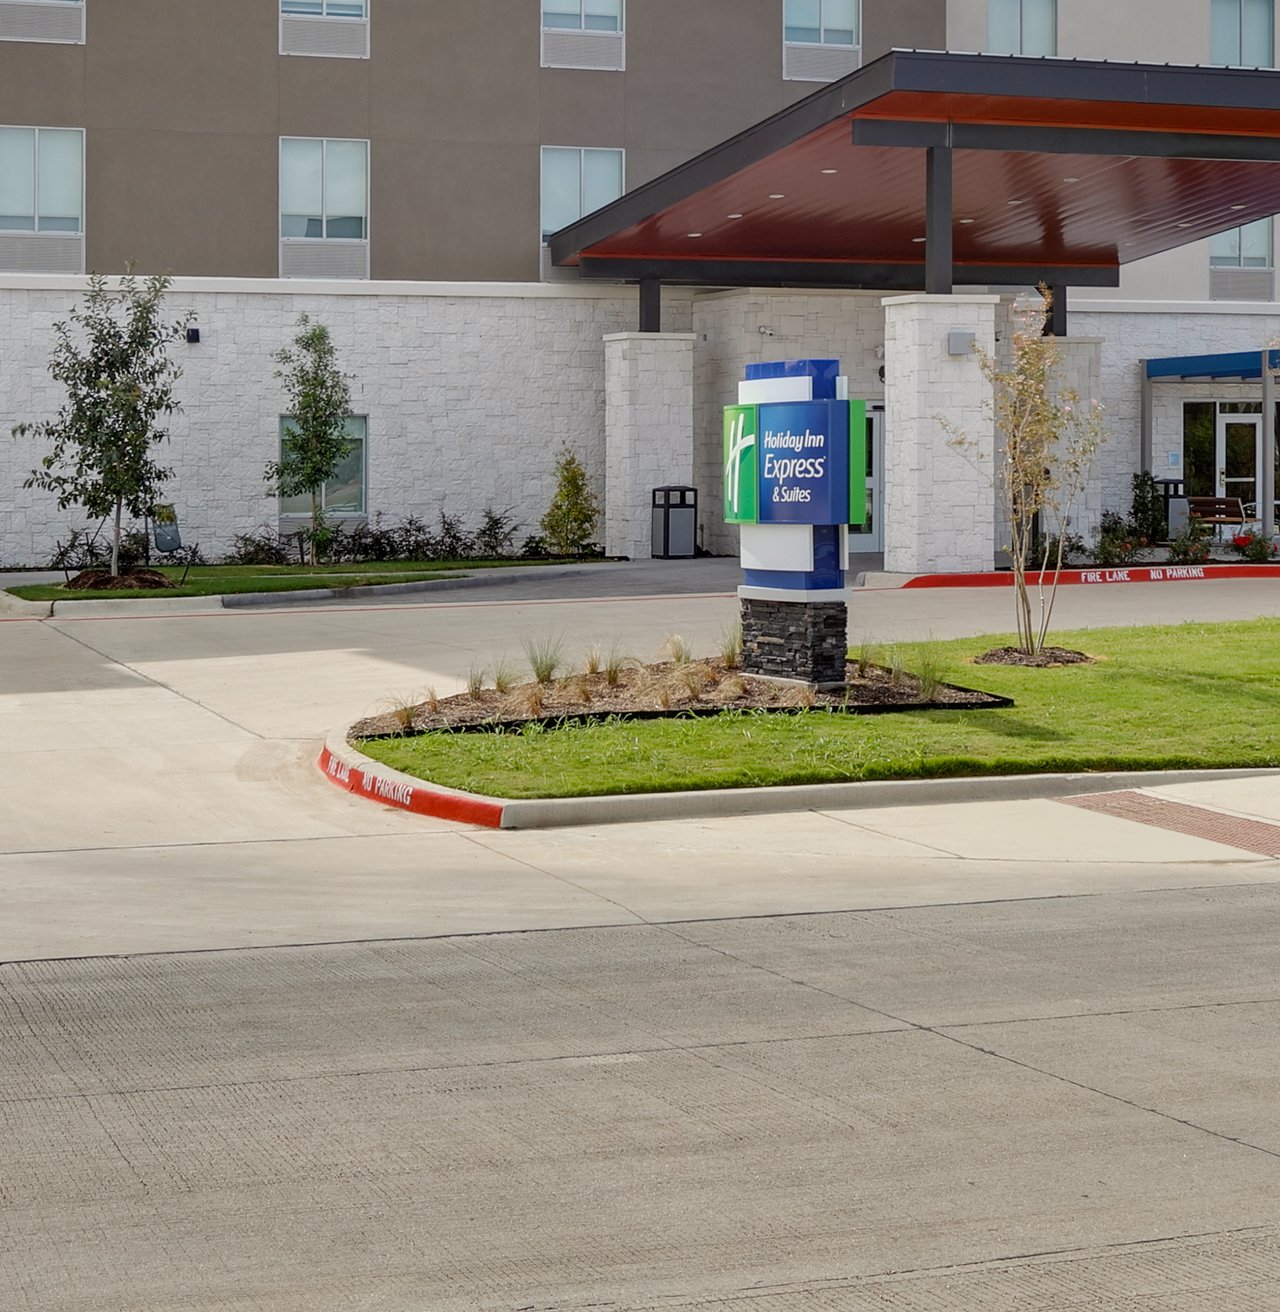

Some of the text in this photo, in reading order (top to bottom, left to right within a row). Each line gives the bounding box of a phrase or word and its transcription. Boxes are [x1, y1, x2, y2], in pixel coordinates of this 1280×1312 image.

[764, 429, 825, 452] Holiday Inn
[764, 453, 826, 485] Express
[772, 486, 811, 502] & Suites
[1081, 567, 1205, 583] FIRE LANE NO PARKING
[362, 772, 373, 791] NO
[374, 776, 414, 805] PARKING
